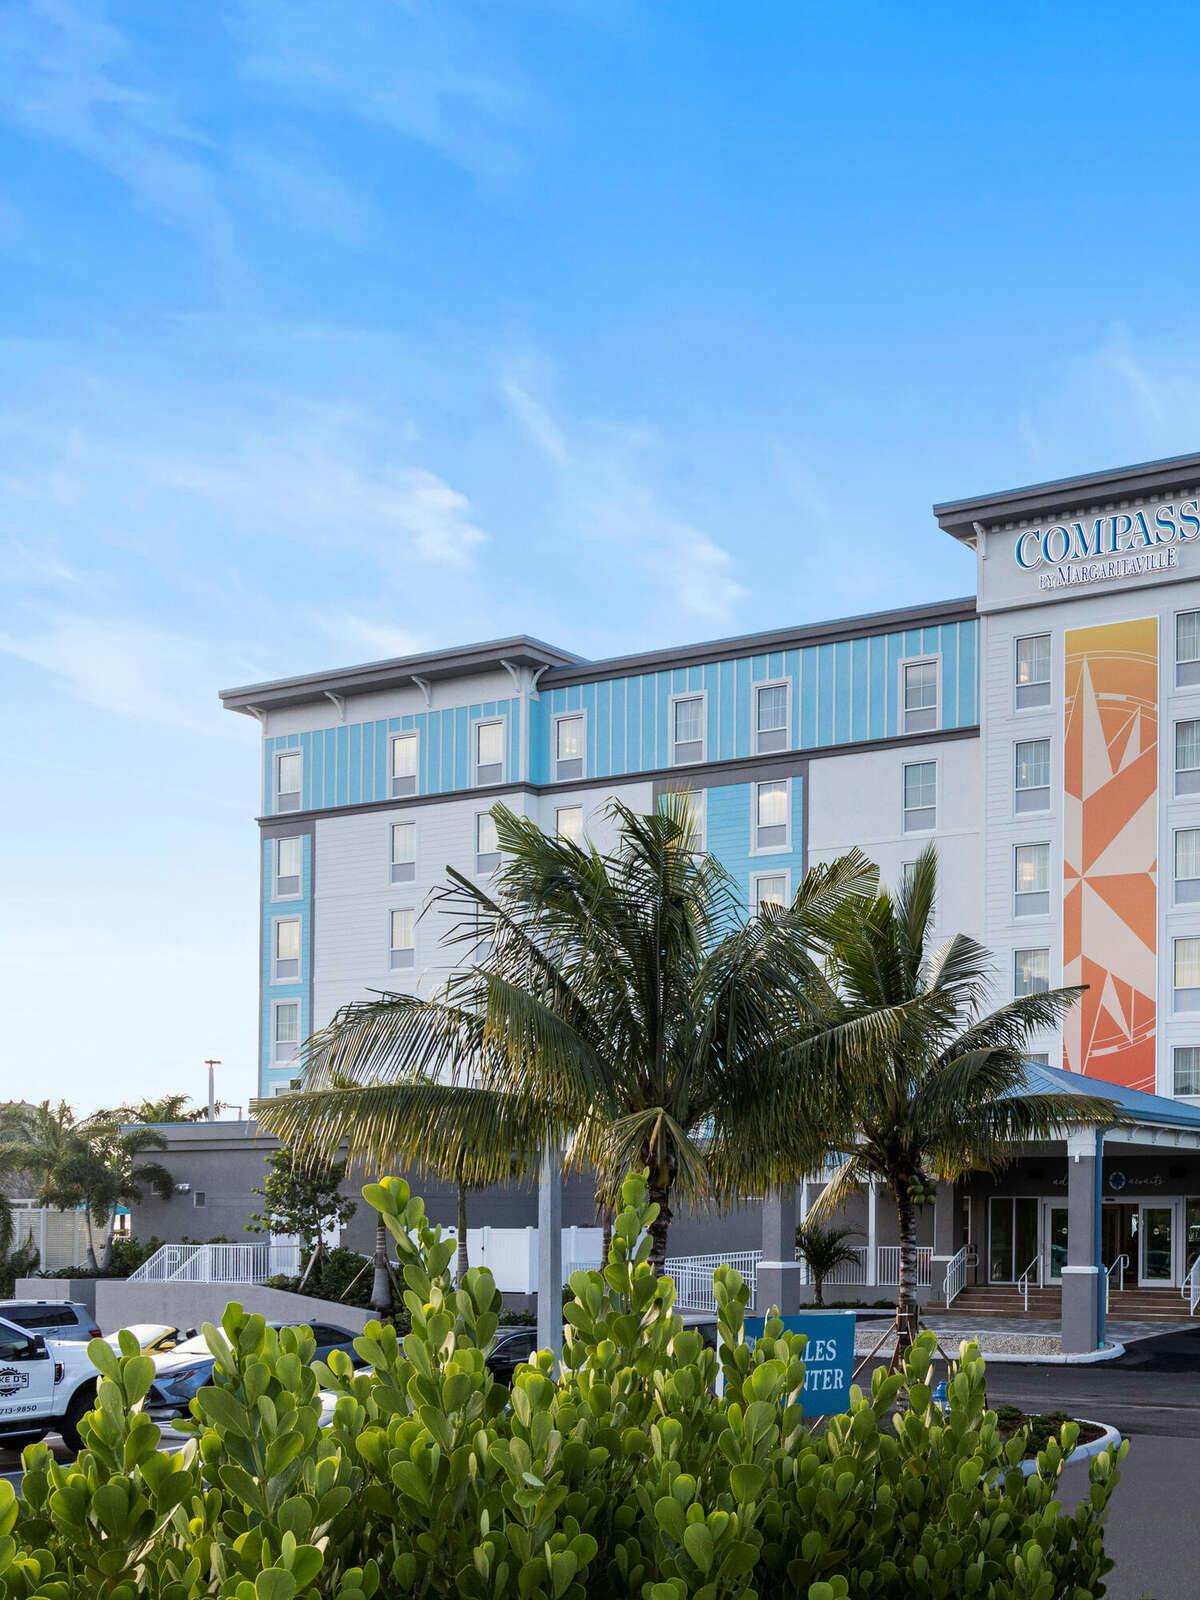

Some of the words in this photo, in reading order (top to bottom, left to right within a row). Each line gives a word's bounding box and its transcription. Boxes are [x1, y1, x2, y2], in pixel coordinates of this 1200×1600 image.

[1040, 574, 1056, 589] BY
[800, 1339, 837, 1361] LES
[0, 1376, 10, 1384] KE
